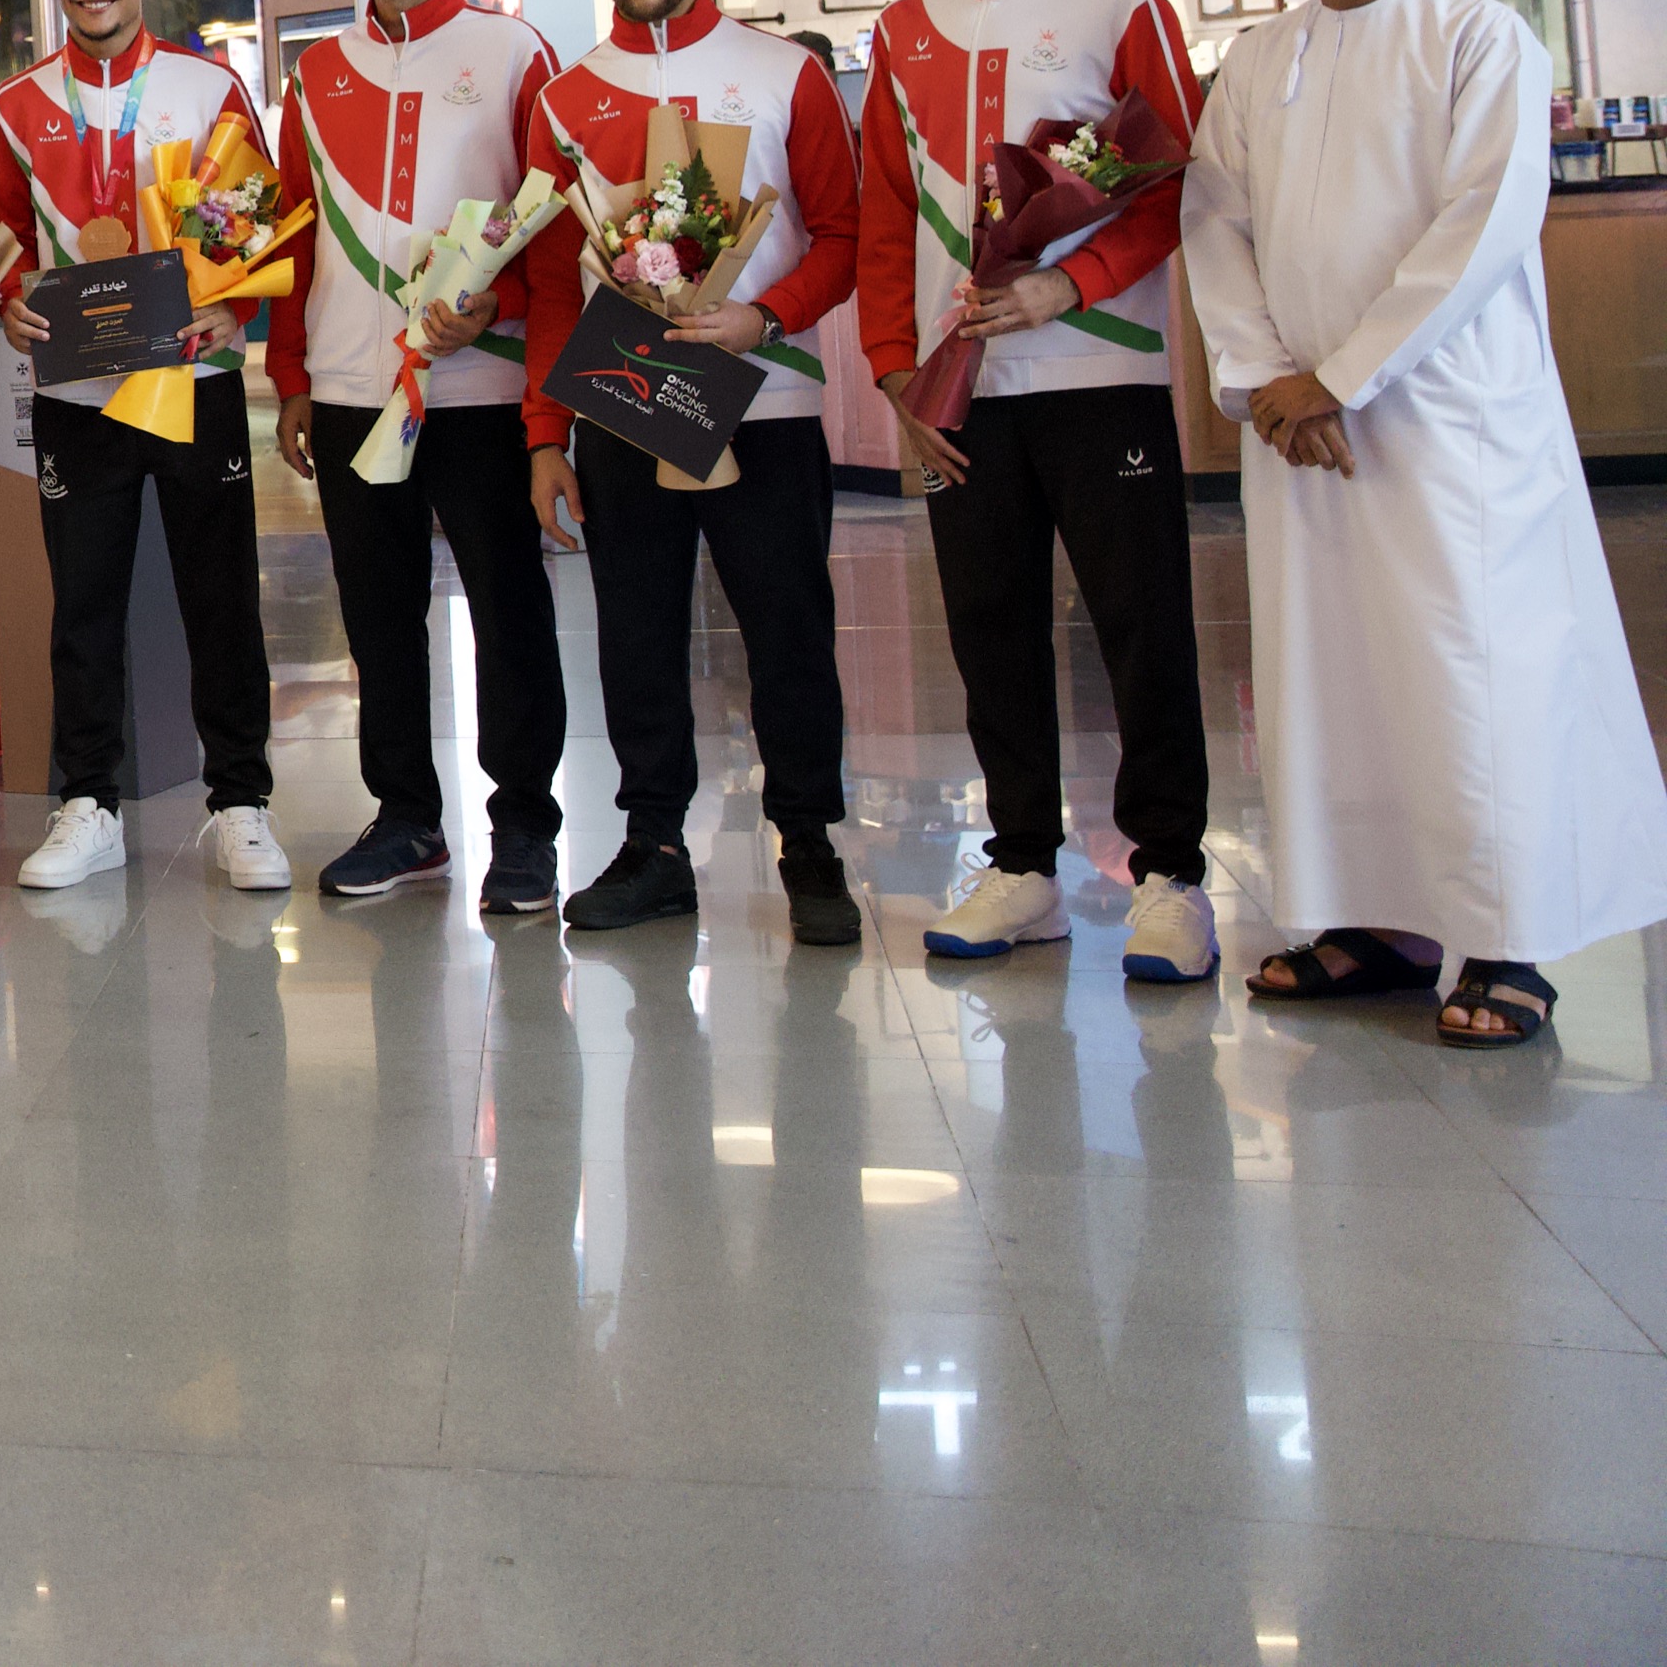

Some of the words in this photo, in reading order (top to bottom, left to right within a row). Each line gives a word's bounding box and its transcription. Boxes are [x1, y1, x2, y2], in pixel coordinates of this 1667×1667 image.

[983, 58, 999, 146] OMA
[588, 110, 621, 122] VALOUR
[394, 100, 415, 212] OMAN
[103, 280, 128, 292] شهادة
[661, 383, 708, 414] FENCING
[667, 374, 701, 397] OMAN
[655, 393, 716, 431] COMMITTEE
[1117, 466, 1153, 477] VALOUR
